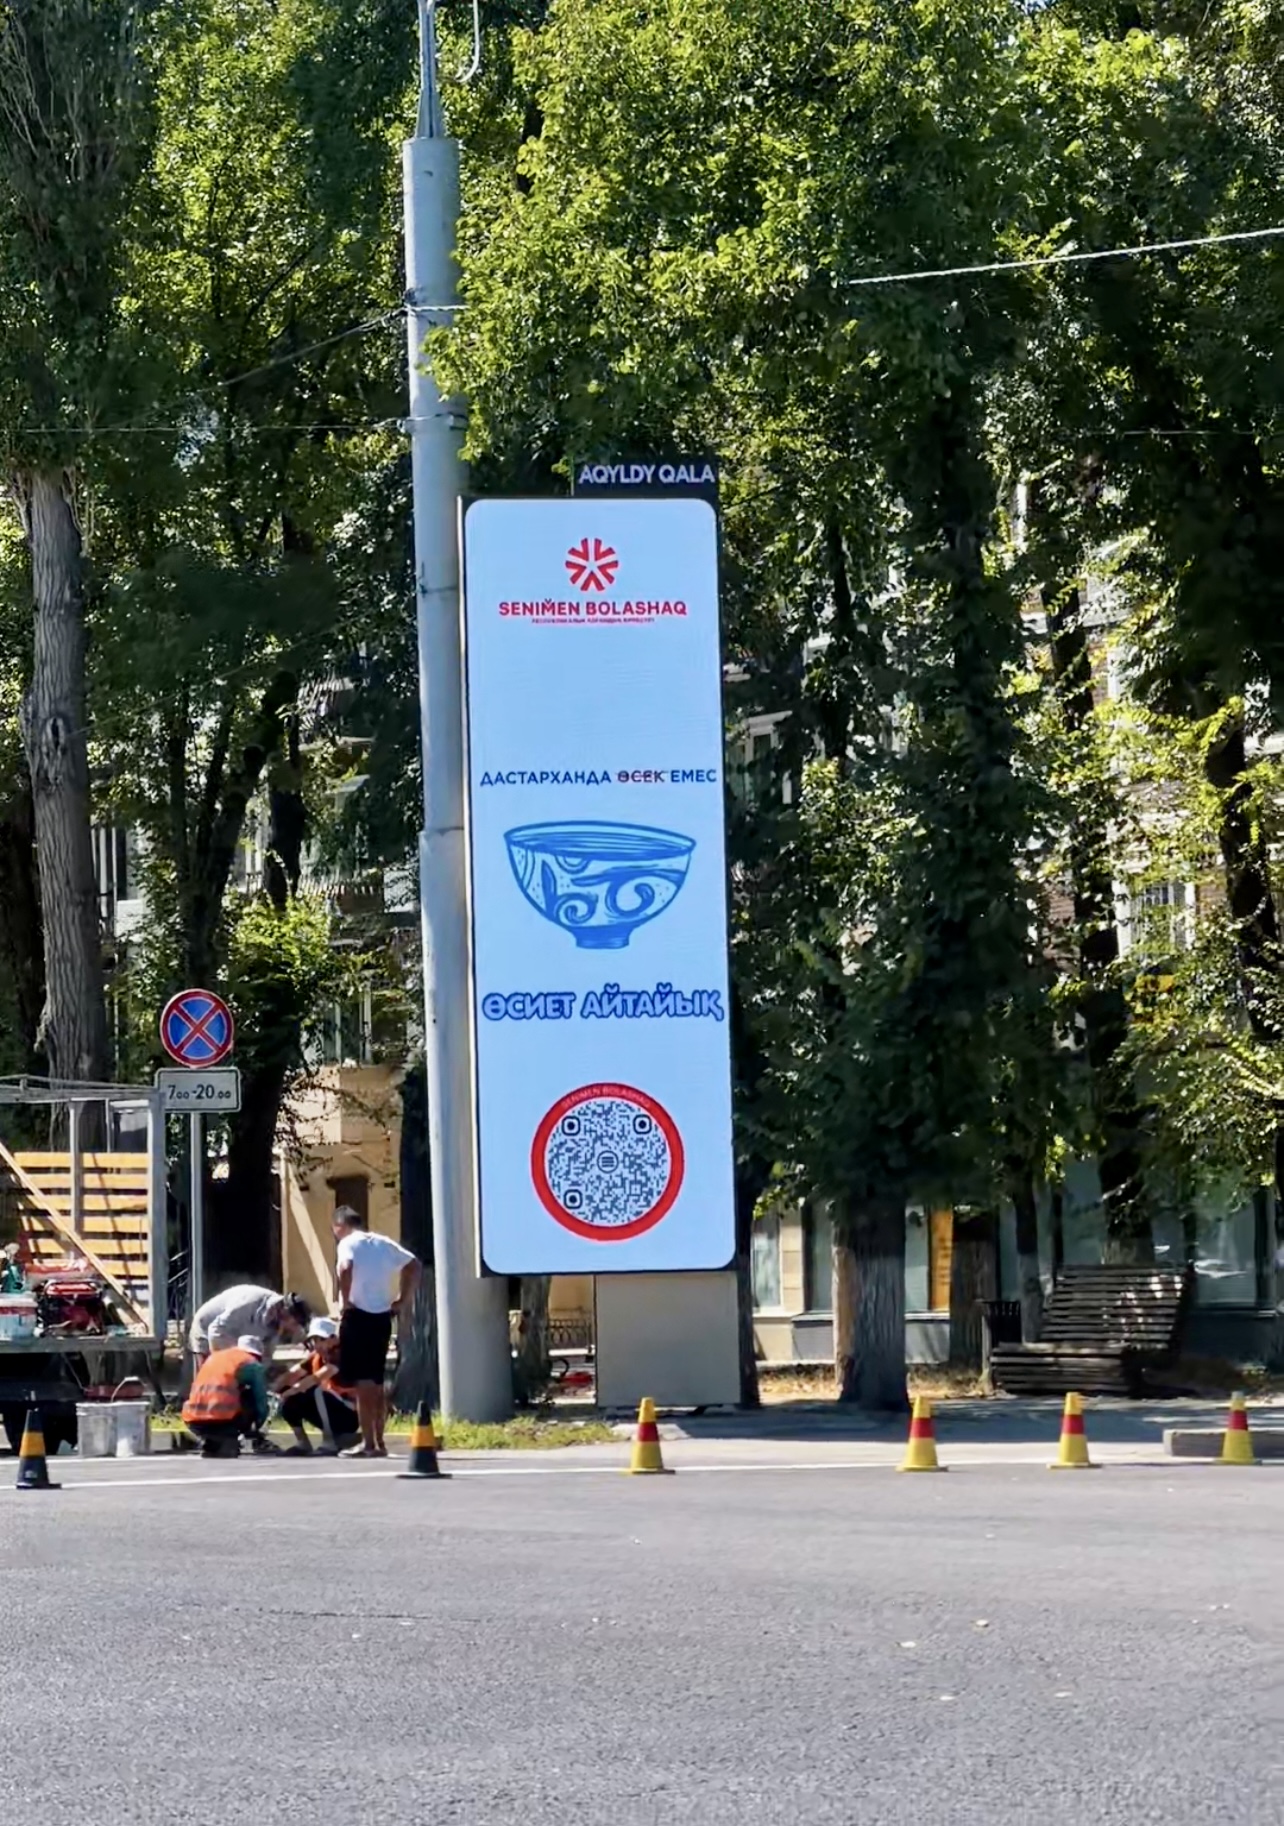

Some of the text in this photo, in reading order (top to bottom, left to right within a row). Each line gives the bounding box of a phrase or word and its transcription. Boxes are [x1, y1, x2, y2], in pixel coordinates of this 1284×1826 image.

[579, 464, 715, 484] AQYLDY QALA
[585, 601, 687, 615] BOLASHAQ
[480, 771, 612, 787] ДАСТАРХАНДА
[671, 769, 717, 783] ЕМЕС
[482, 983, 725, 1022] ӨСИЕТ АЙТАЙЫҚ
